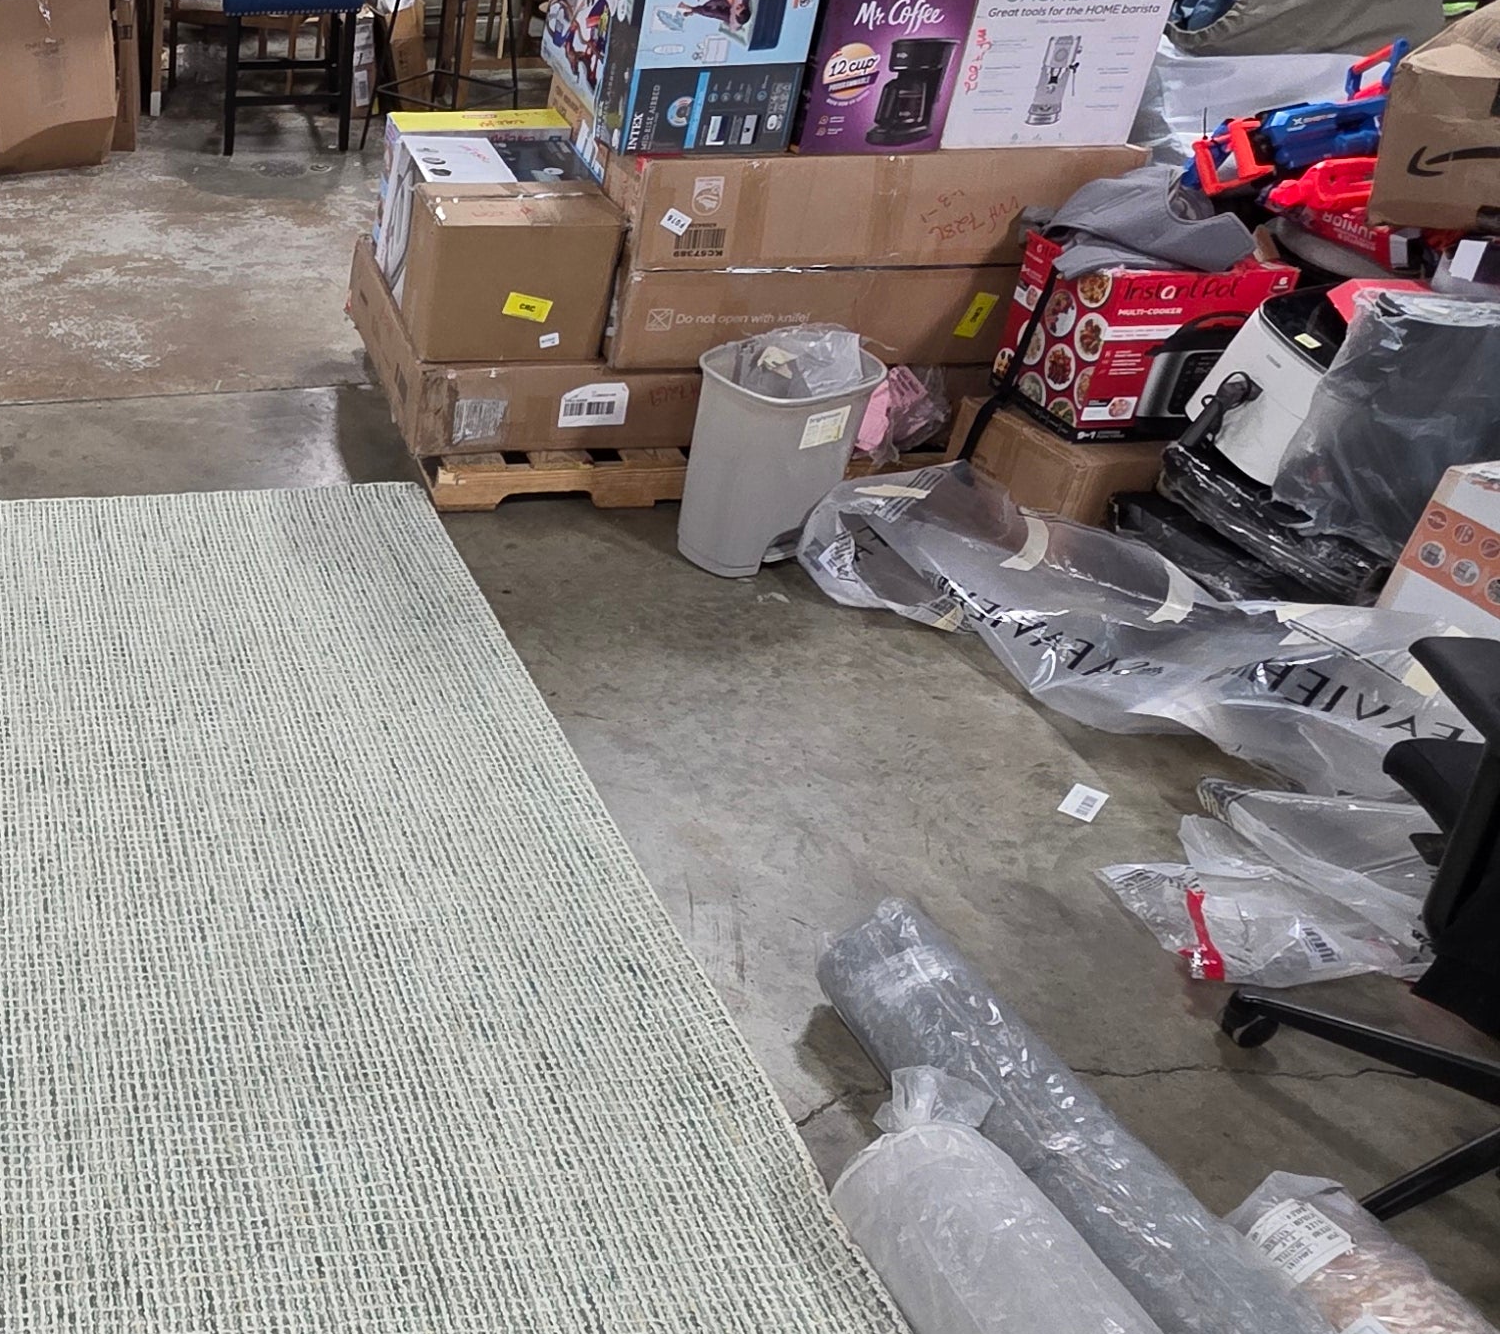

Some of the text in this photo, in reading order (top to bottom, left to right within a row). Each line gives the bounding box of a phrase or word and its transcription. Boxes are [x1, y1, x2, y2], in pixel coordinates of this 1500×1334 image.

[853, 0, 886, 28] Mr.
[987, 4, 1160, 17] Great tools for the HOME barista
[829, 57, 879, 78] 12 cup
[648, 84, 661, 114] AIRBED
[626, 112, 644, 152] INTEX
[1321, 211, 1378, 240] JUNIOR
[1123, 276, 1240, 302] Instant Pot
[675, 312, 811, 326] Do not open with knife!
[1117, 307, 1183, 317] MULTI-COOKER
